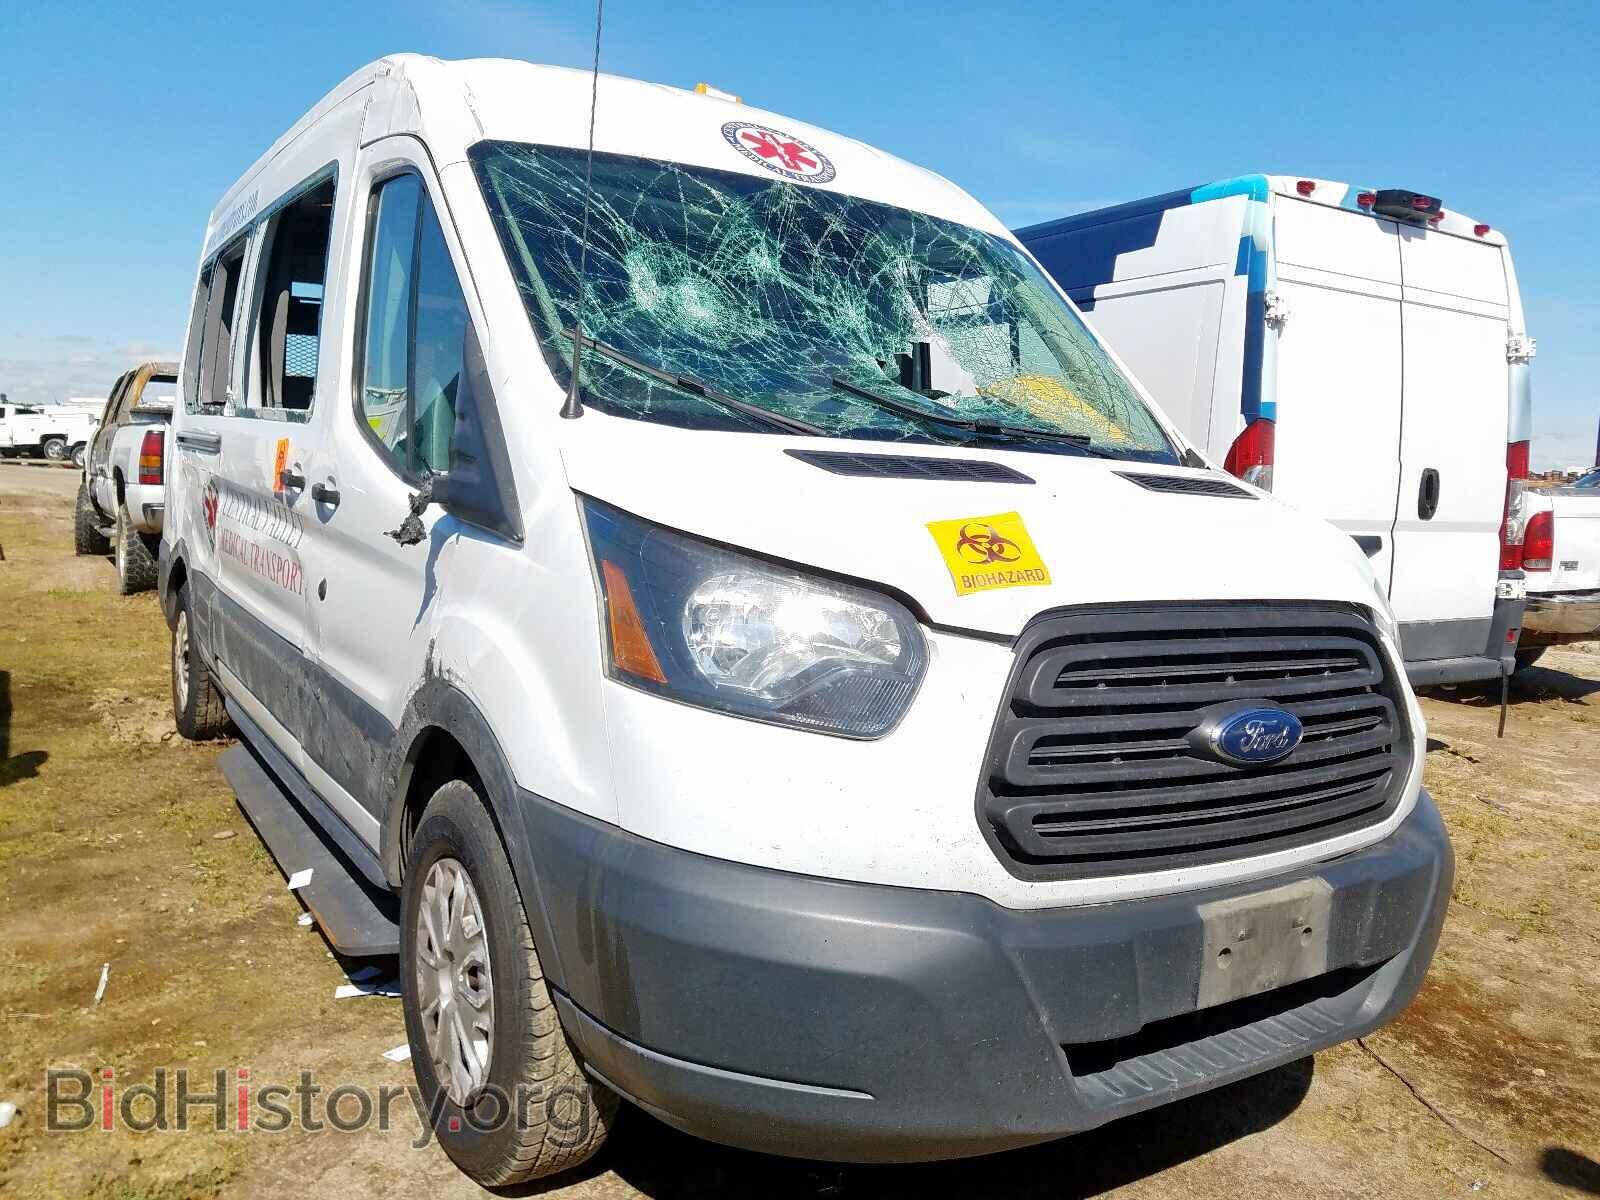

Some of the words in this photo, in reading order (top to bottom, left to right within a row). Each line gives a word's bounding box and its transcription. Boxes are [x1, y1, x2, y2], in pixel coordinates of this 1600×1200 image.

[250, 542, 304, 595] TRANSPORT
[961, 568, 1046, 590] BIOHAZARD
[1239, 719, 1290, 753] Ford
